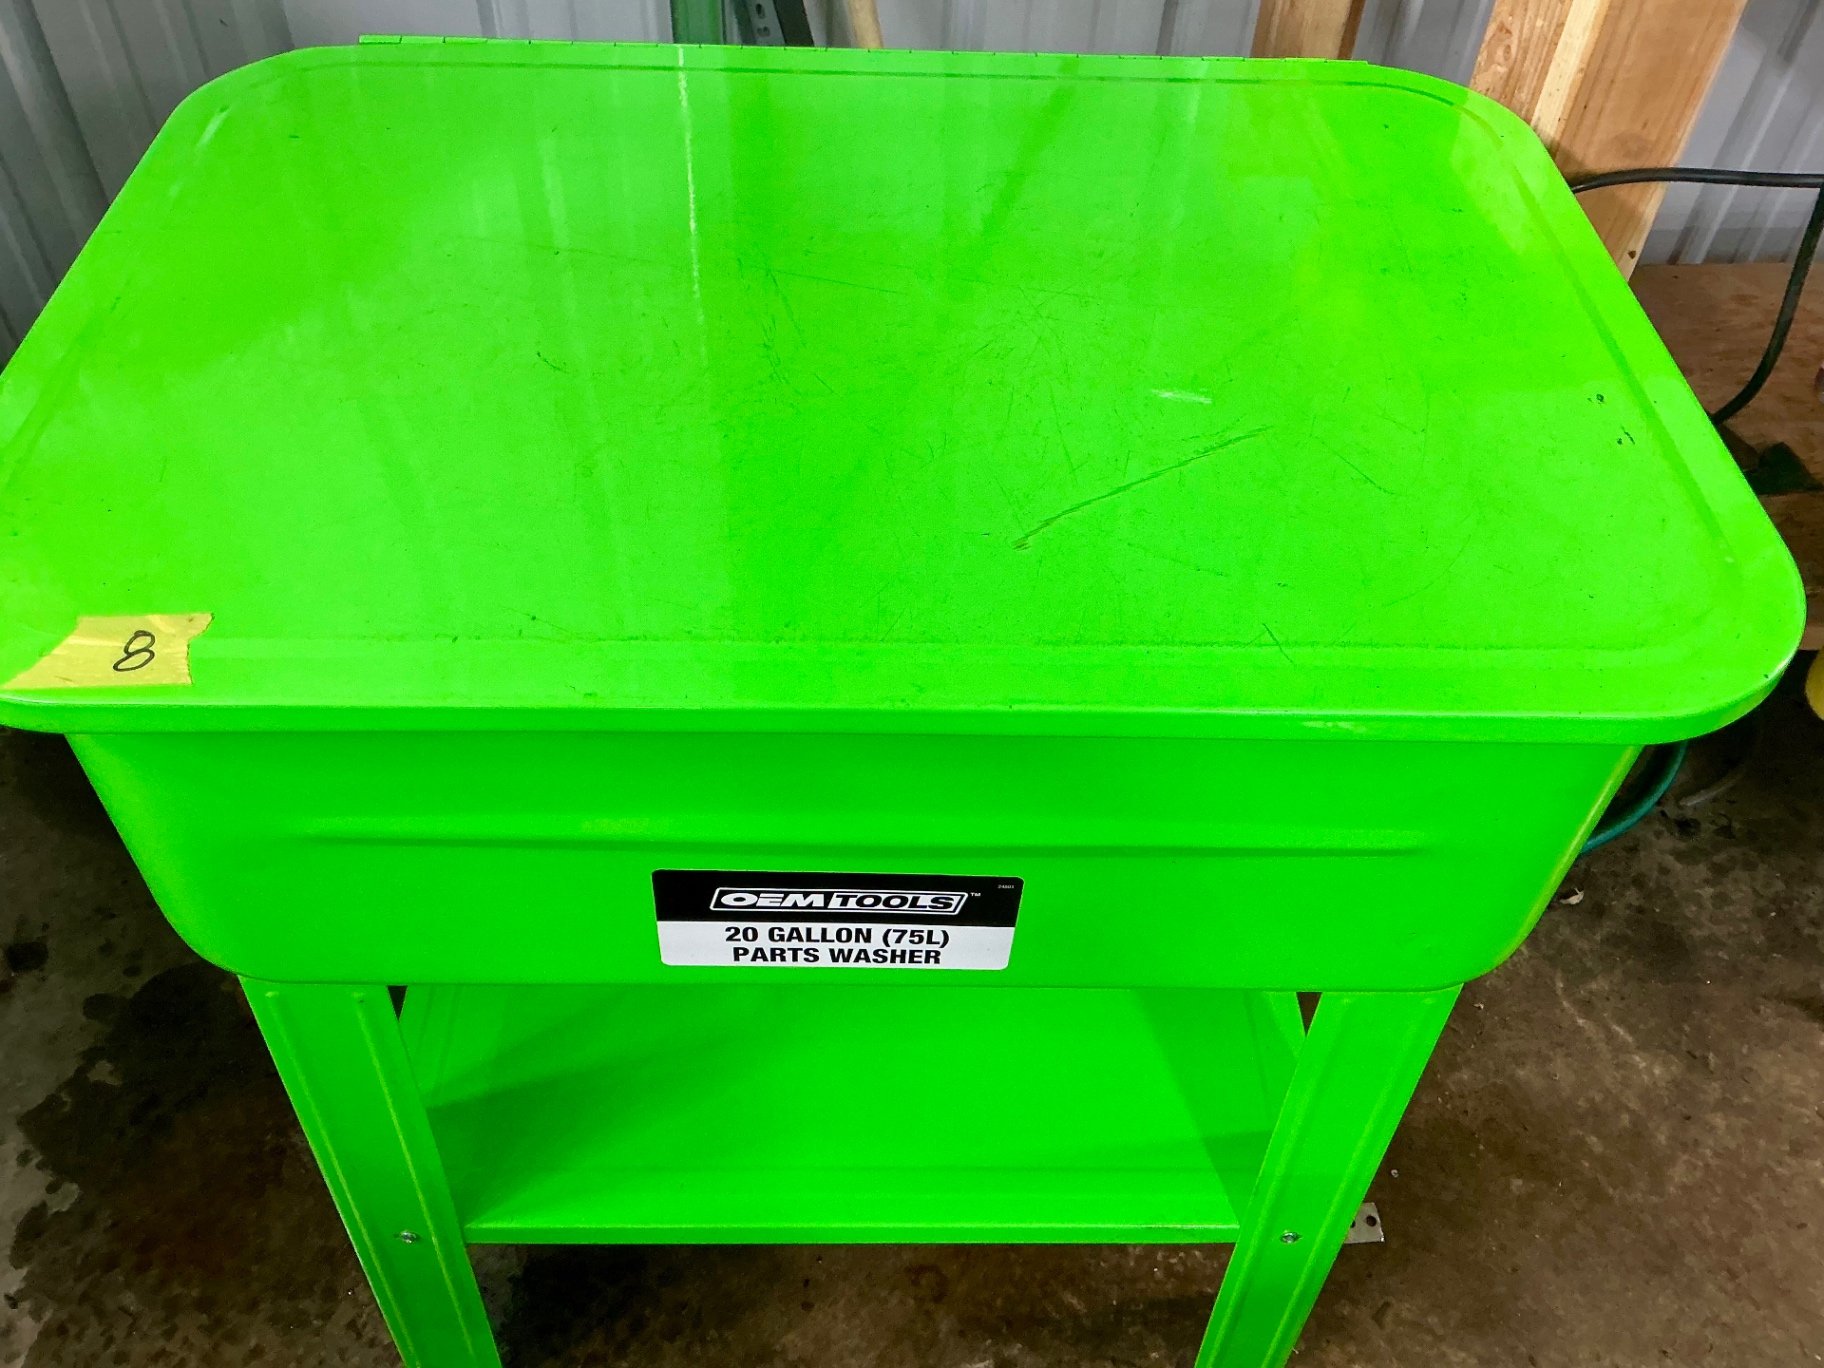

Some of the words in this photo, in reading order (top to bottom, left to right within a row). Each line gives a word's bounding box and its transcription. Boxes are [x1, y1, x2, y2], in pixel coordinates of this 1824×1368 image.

[113, 630, 155, 671] 8
[725, 926, 758, 943] 20
[768, 927, 872, 944] GALLON
[882, 928, 950, 949] (75L)
[733, 947, 819, 963] PARTS
[831, 949, 941, 965] WASHER
